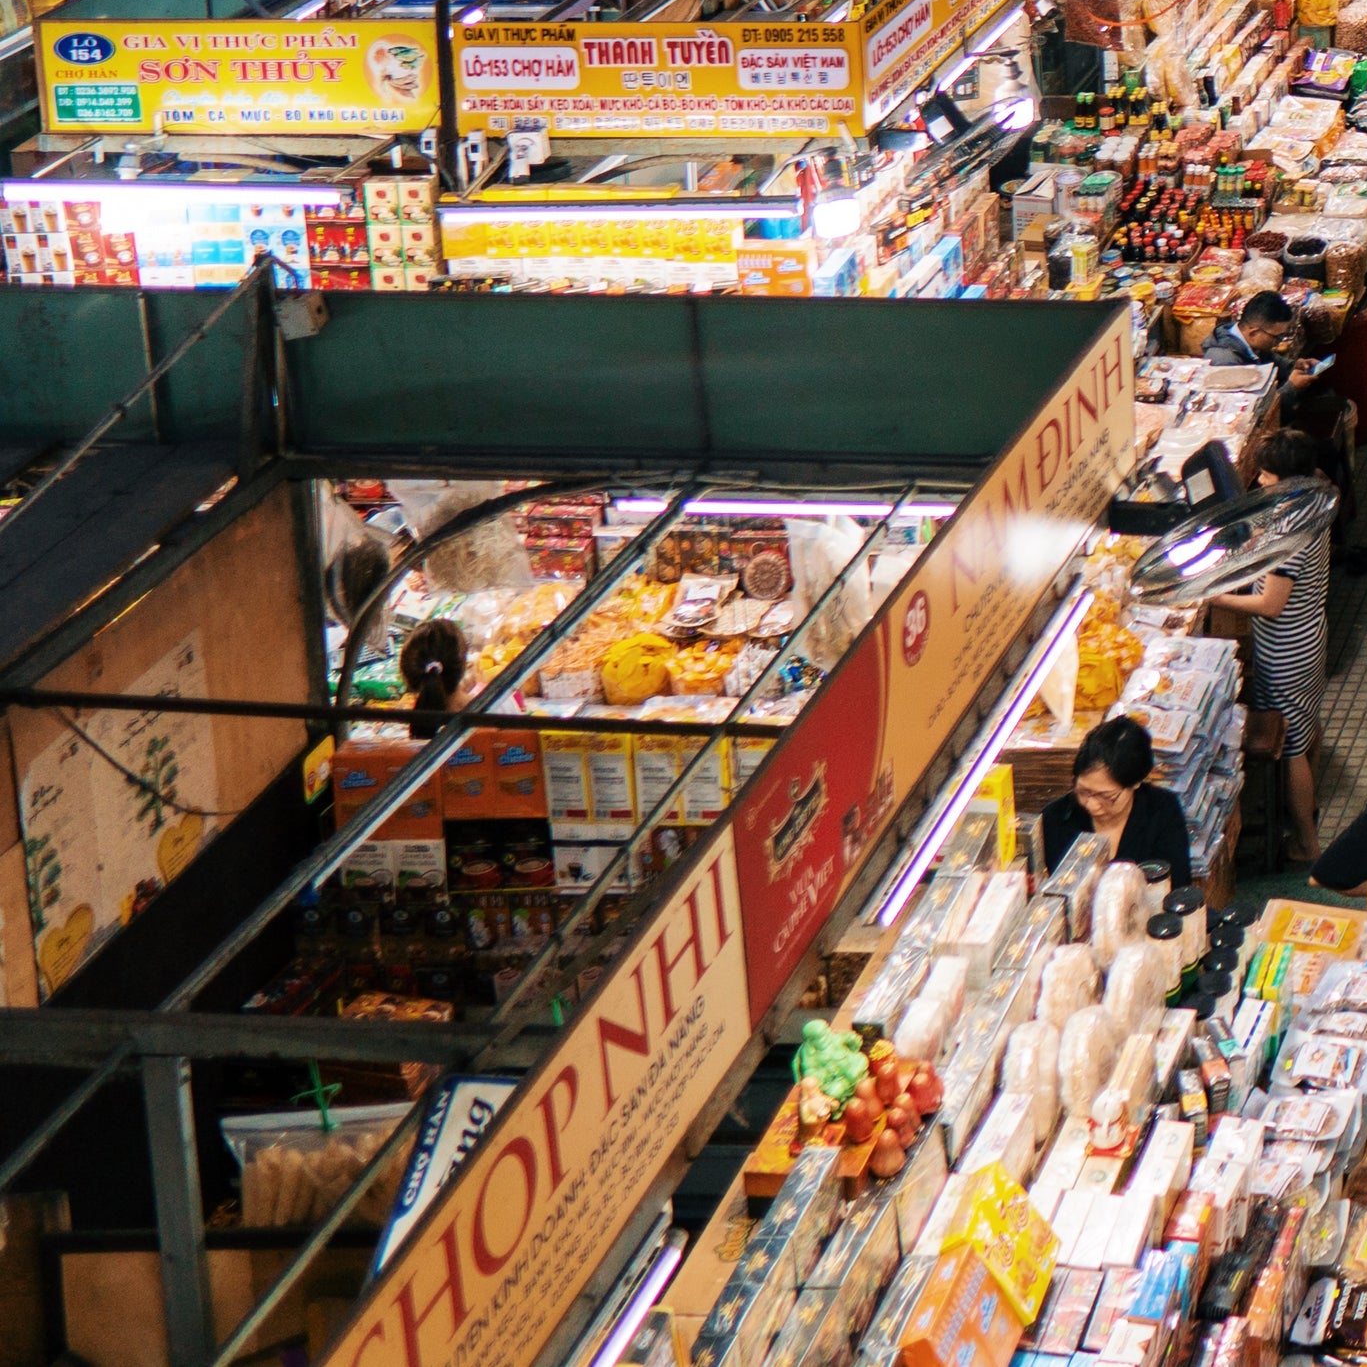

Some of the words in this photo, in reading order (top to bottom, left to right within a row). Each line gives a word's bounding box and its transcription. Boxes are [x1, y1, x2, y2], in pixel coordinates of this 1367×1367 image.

[72, 36, 97, 47] LÔ
[122, 34, 168, 50] GIA
[175, 34, 202, 52] VỊ
[207, 34, 276, 51] THỰC
[282, 27, 357, 49] PHẨM
[764, 28, 791, 42] 0905
[794, 29, 814, 42] 215
[817, 29, 845, 42] 558
[70, 48, 102, 61] 154
[583, 38, 656, 66] THANH
[55, 68, 85, 80] CHỢ
[88, 67, 118, 79] HÀN
[139, 58, 220, 84] SƠN
[230, 50, 346, 83] THỦY
[512, 56, 542, 81] CHỢ
[545, 52, 575, 77] HÀN
[1035, 334, 1124, 491] ĐỊNH
[904, 600, 926, 652] 36
[596, 851, 736, 1123] NHI
